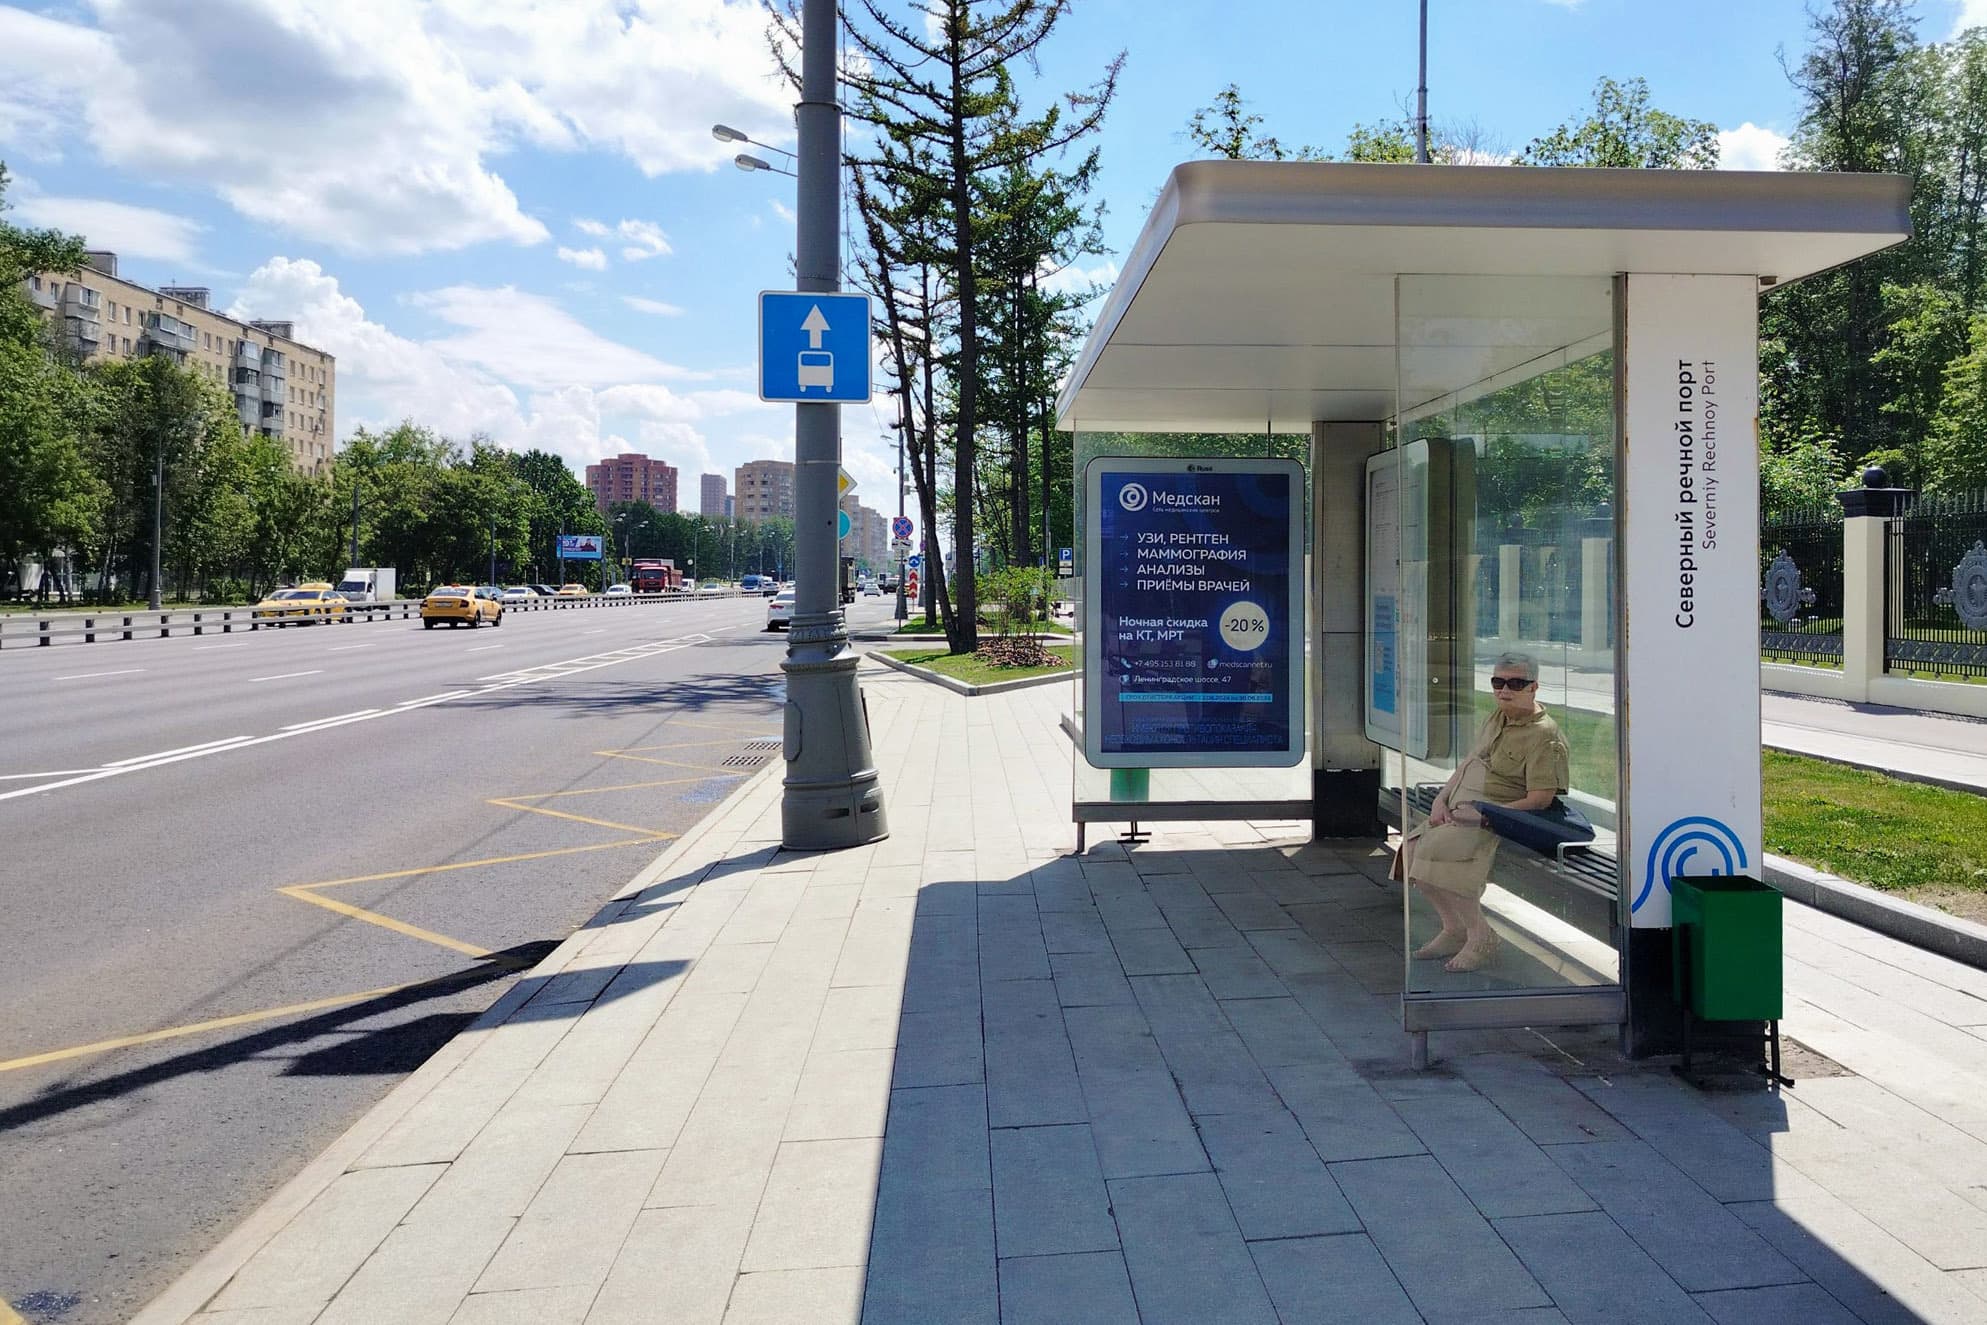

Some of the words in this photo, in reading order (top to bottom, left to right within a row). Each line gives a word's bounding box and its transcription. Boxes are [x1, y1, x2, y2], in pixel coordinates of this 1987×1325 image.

[1702, 360, 1716, 395] Port
[1678, 359, 1697, 413] порт
[1702, 400, 1719, 472] Rechnoy
[1675, 420, 1698, 503] речной
[1153, 491, 1220, 507] Медскан
[1702, 477, 1719, 550] Severniy
[1137, 533, 1167, 546] УЗИ,
[1169, 533, 1229, 545] РЕНТГЕН
[1062, 550, 1070, 560] P
[1137, 548, 1247, 561] МАММОГРАФИЯ
[1136, 564, 1205, 575] АНАЛИЗЫ
[1675, 511, 1698, 629] Северный
[1137, 579, 1195, 591] ПРИЁМЫ
[1199, 579, 1250, 592] ВРАЧЕЙ
[1119, 616, 1163, 628] Ночная
[1166, 618, 1208, 628] скидка
[1119, 632, 1133, 640] на
[1136, 631, 1155, 642] КТ,
[1157, 631, 1184, 641] МРТ
[1133, 675, 1193, 684] Ленинградское
[1222, 675, 1231, 683] 47
